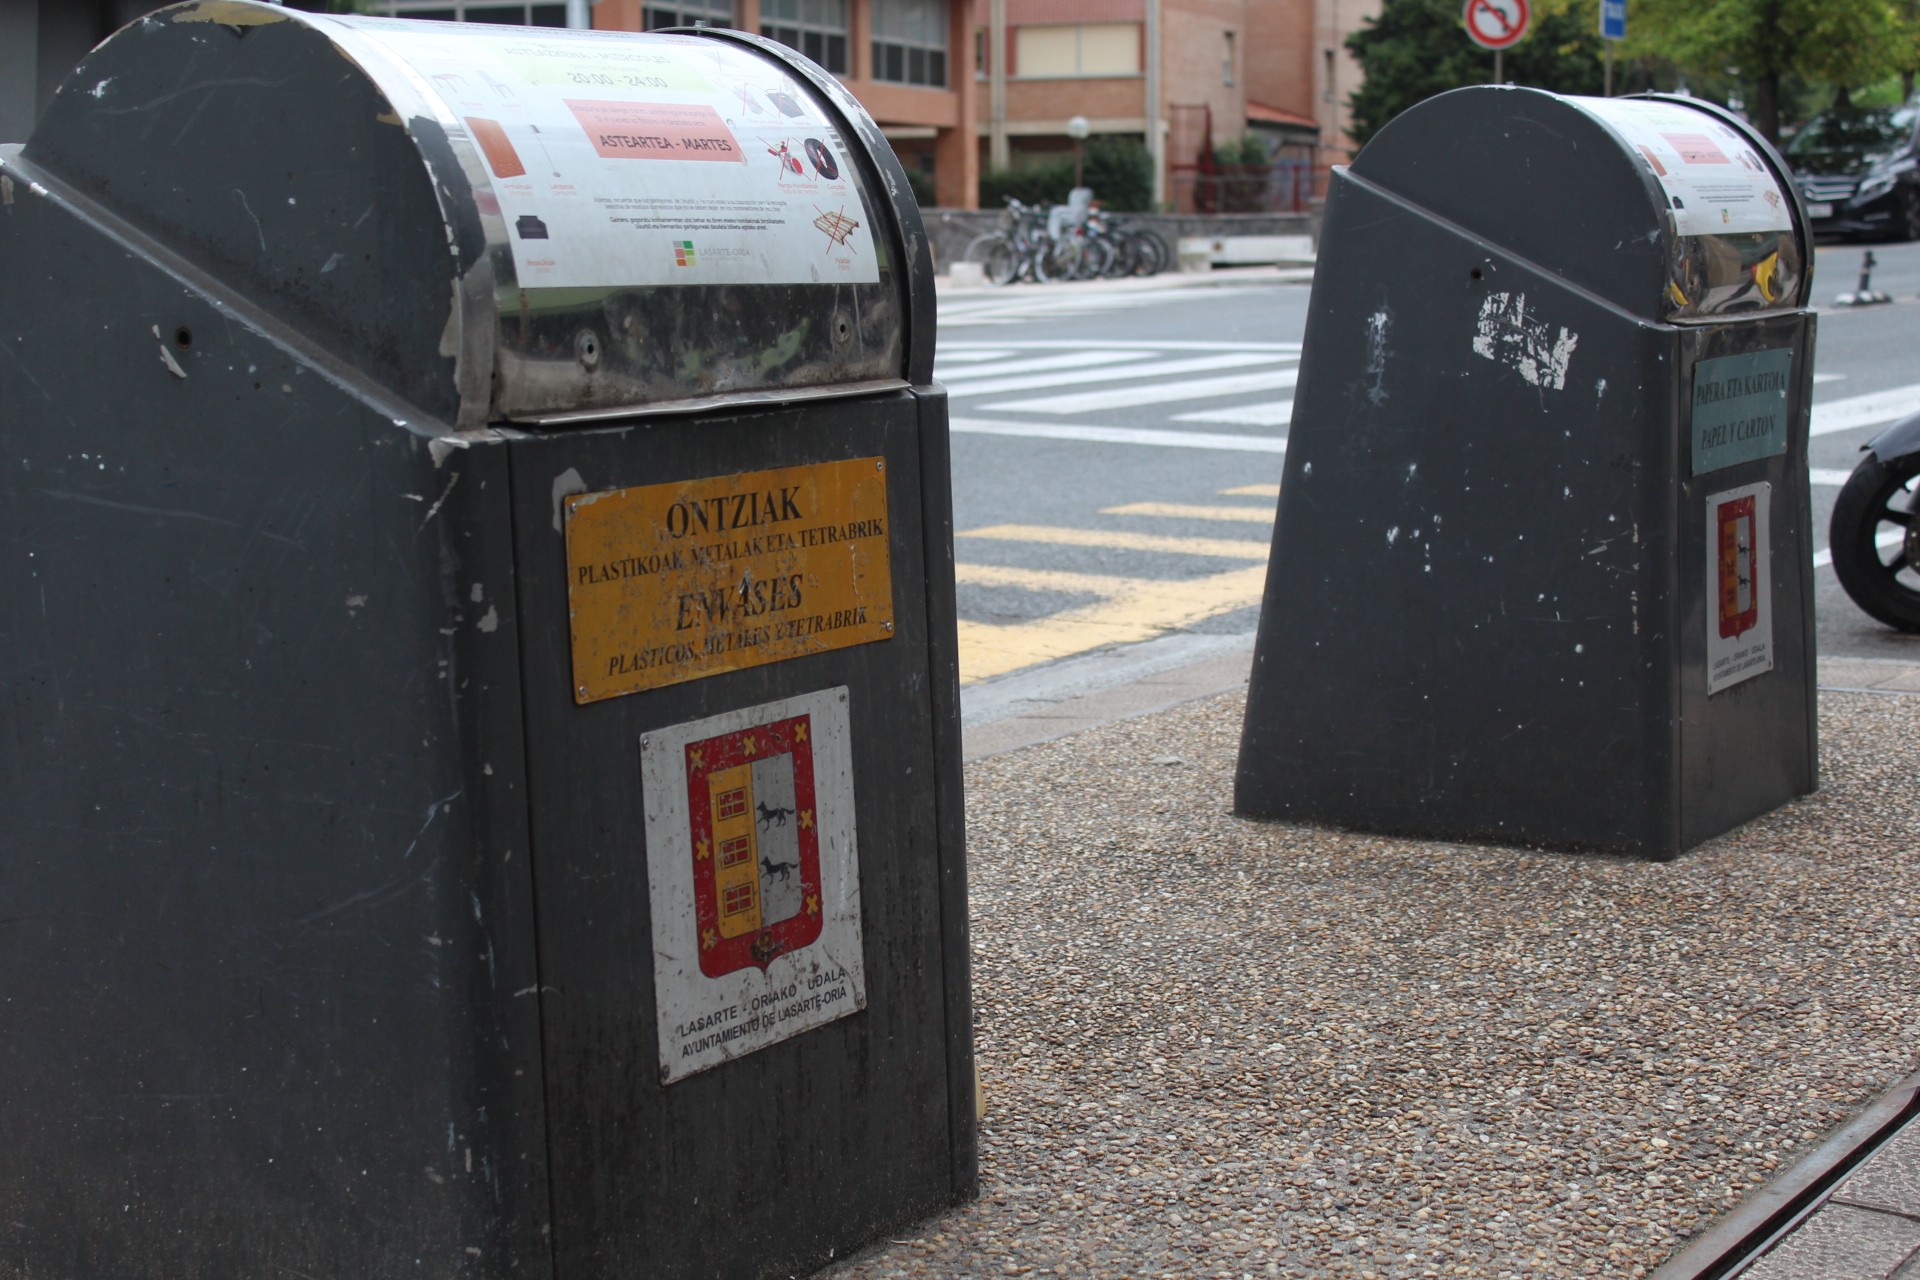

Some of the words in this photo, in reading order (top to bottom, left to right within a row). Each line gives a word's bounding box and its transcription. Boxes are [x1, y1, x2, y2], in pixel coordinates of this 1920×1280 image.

[567, 72, 614, 86] 20:00
[624, 75, 668, 88] 24:00
[599, 134, 673, 149] ASTEARTEA
[682, 138, 733, 152] MARTES
[697, 247, 751, 257] LASARTE-ORIA
[1696, 382, 1725, 406] PAPERA
[1726, 377, 1743, 399] ETA
[1744, 371, 1785, 395] KARTOIA
[1701, 424, 1727, 450] PAPEL
[1730, 421, 1737, 442] Y
[1737, 414, 1777, 441] CARTON
[666, 486, 803, 539] ONTZIAK
[690, 537, 764, 566] METALAK
[767, 533, 797, 552] ETA
[798, 518, 884, 547] TETRABRIK
[675, 573, 804, 631] ENVASES
[703, 623, 772, 656] METALES
[788, 606, 867, 636] TETRABRIK
[680, 1005, 738, 1038] LASARTE
[751, 984, 797, 1011] ORIAKO
[807, 968, 846, 990] UDALA
[681, 1017, 760, 1059] AYUNTAMIENTO
[762, 1012, 776, 1029] DE
[778, 985, 847, 1022] LASARTE-ORIA
